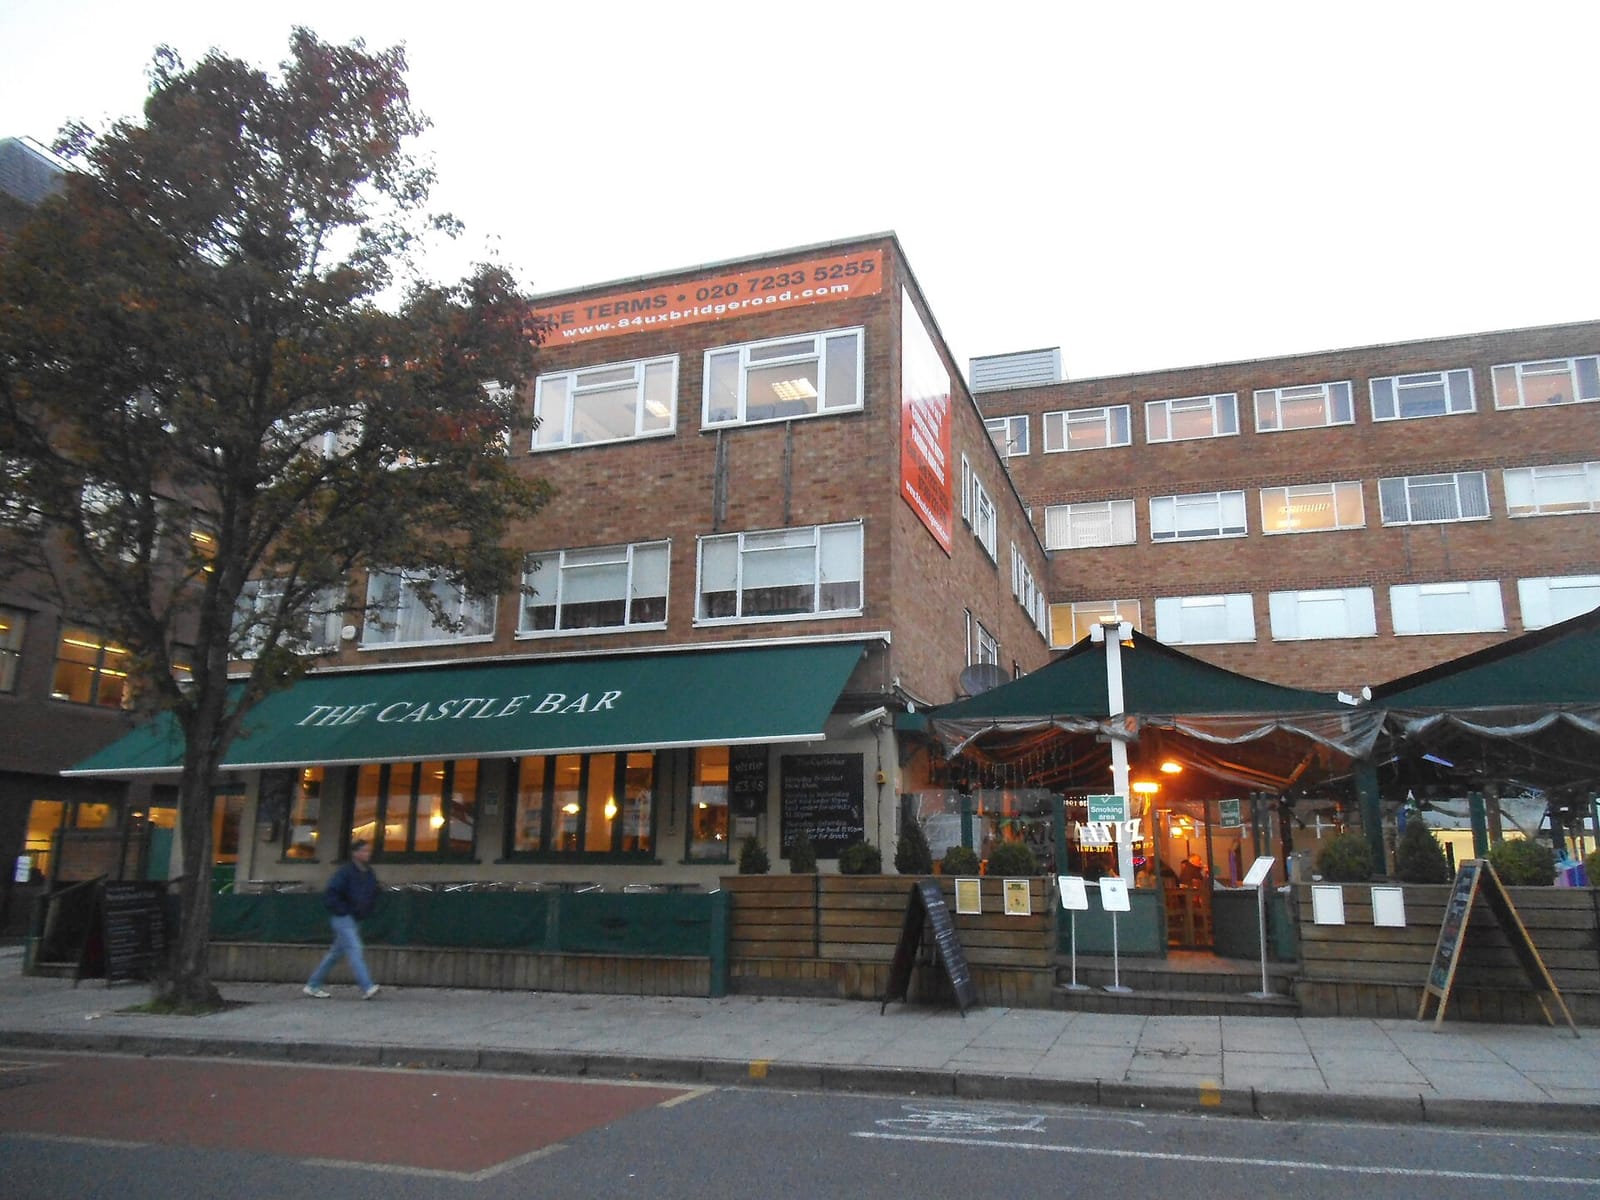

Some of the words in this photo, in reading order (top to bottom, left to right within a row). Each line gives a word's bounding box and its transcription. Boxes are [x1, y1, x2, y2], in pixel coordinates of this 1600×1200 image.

[561, 282, 850, 338] www.84uxbridgeroad.com
[585, 293, 668, 320] TERMS
[695, 281, 739, 302] 020
[748, 270, 806, 293] 7233
[813, 258, 876, 282] 5255
[296, 702, 378, 726] THE
[376, 694, 532, 723] CASTLE
[529, 689, 623, 714] BAR
[1090, 805, 1123, 814] Smoking
